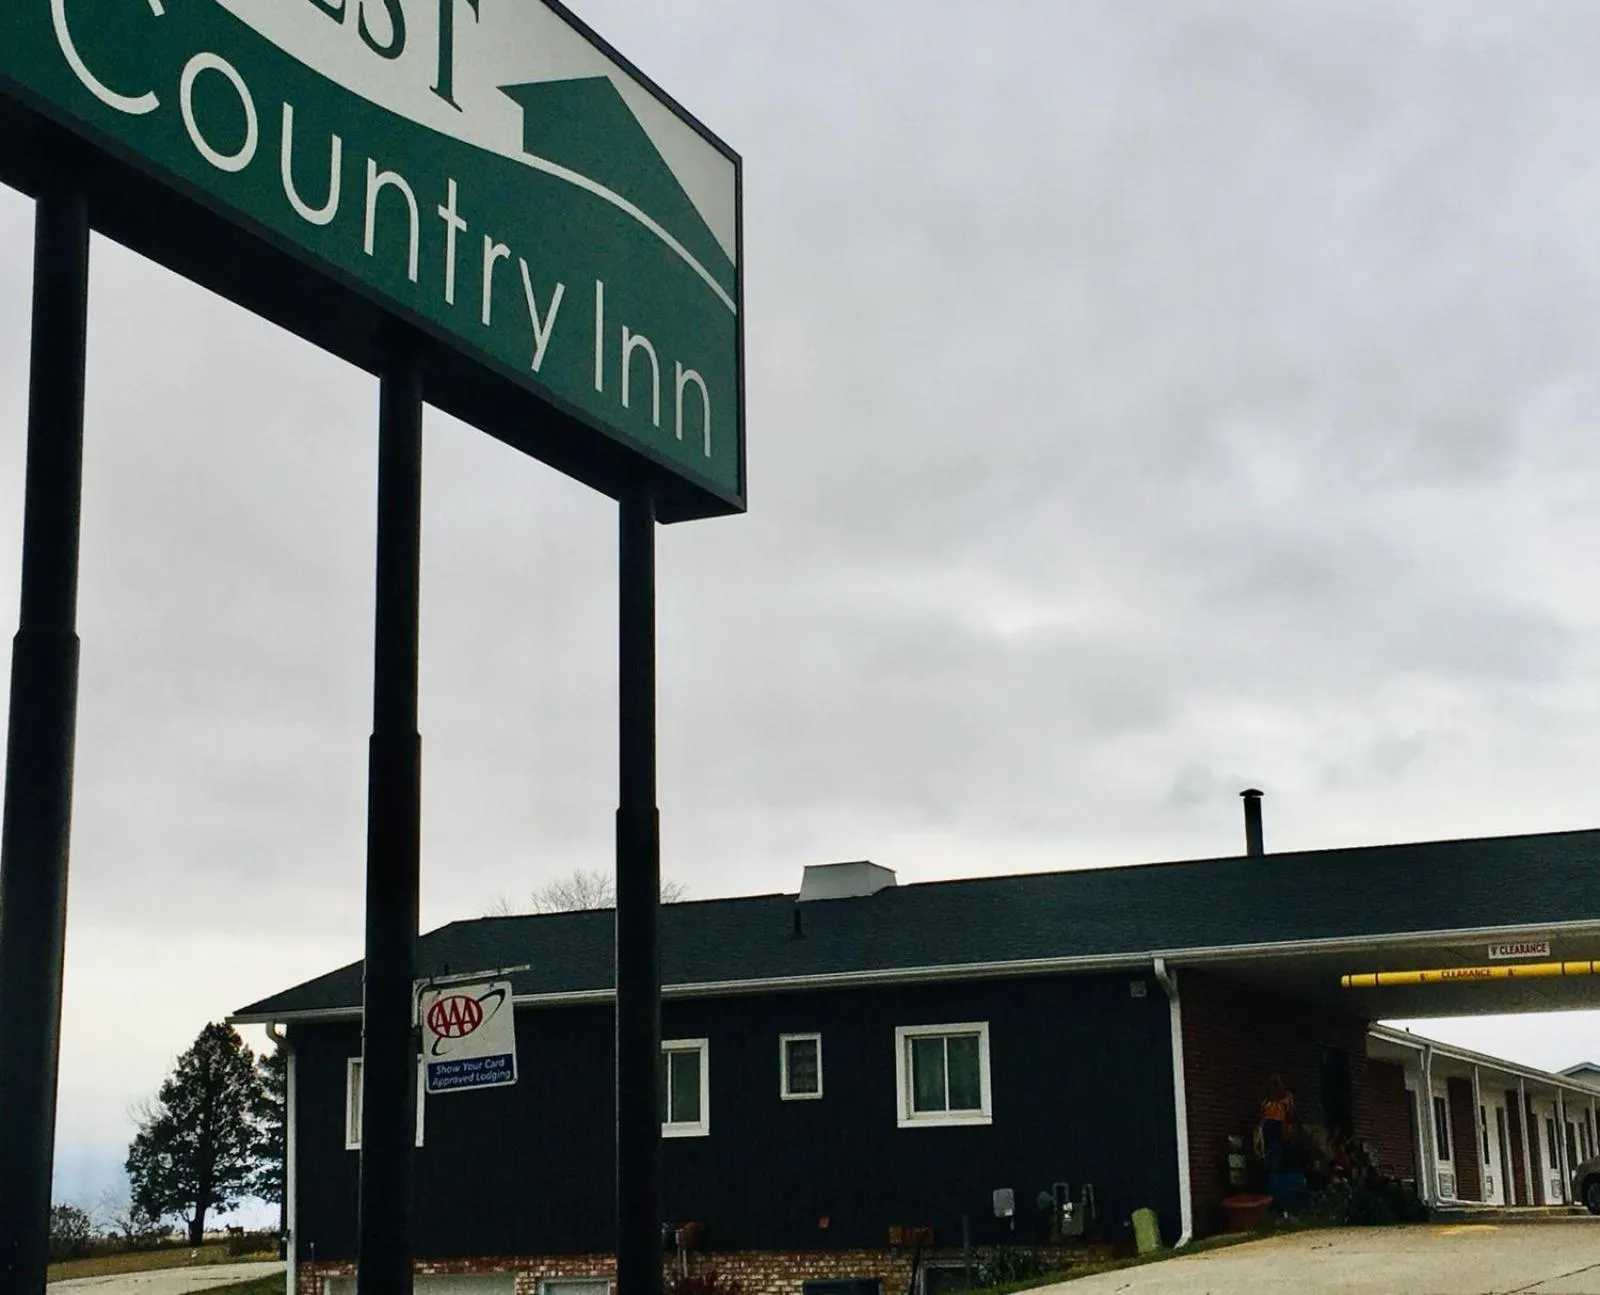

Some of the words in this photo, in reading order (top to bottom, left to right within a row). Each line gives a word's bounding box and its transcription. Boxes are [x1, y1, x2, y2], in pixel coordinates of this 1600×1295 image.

[51, 0, 564, 373] Country
[595, 278, 711, 458] Inn
[1499, 942, 1547, 956] CLEARANCE
[1440, 968, 1493, 979] CLEARANCE
[431, 996, 480, 1037] AAA
[435, 1064, 461, 1075] Show
[462, 1061, 482, 1072] Your
[484, 1057, 505, 1069] Card
[432, 1072, 475, 1087] Approved
[476, 1070, 511, 1083] Lodging
